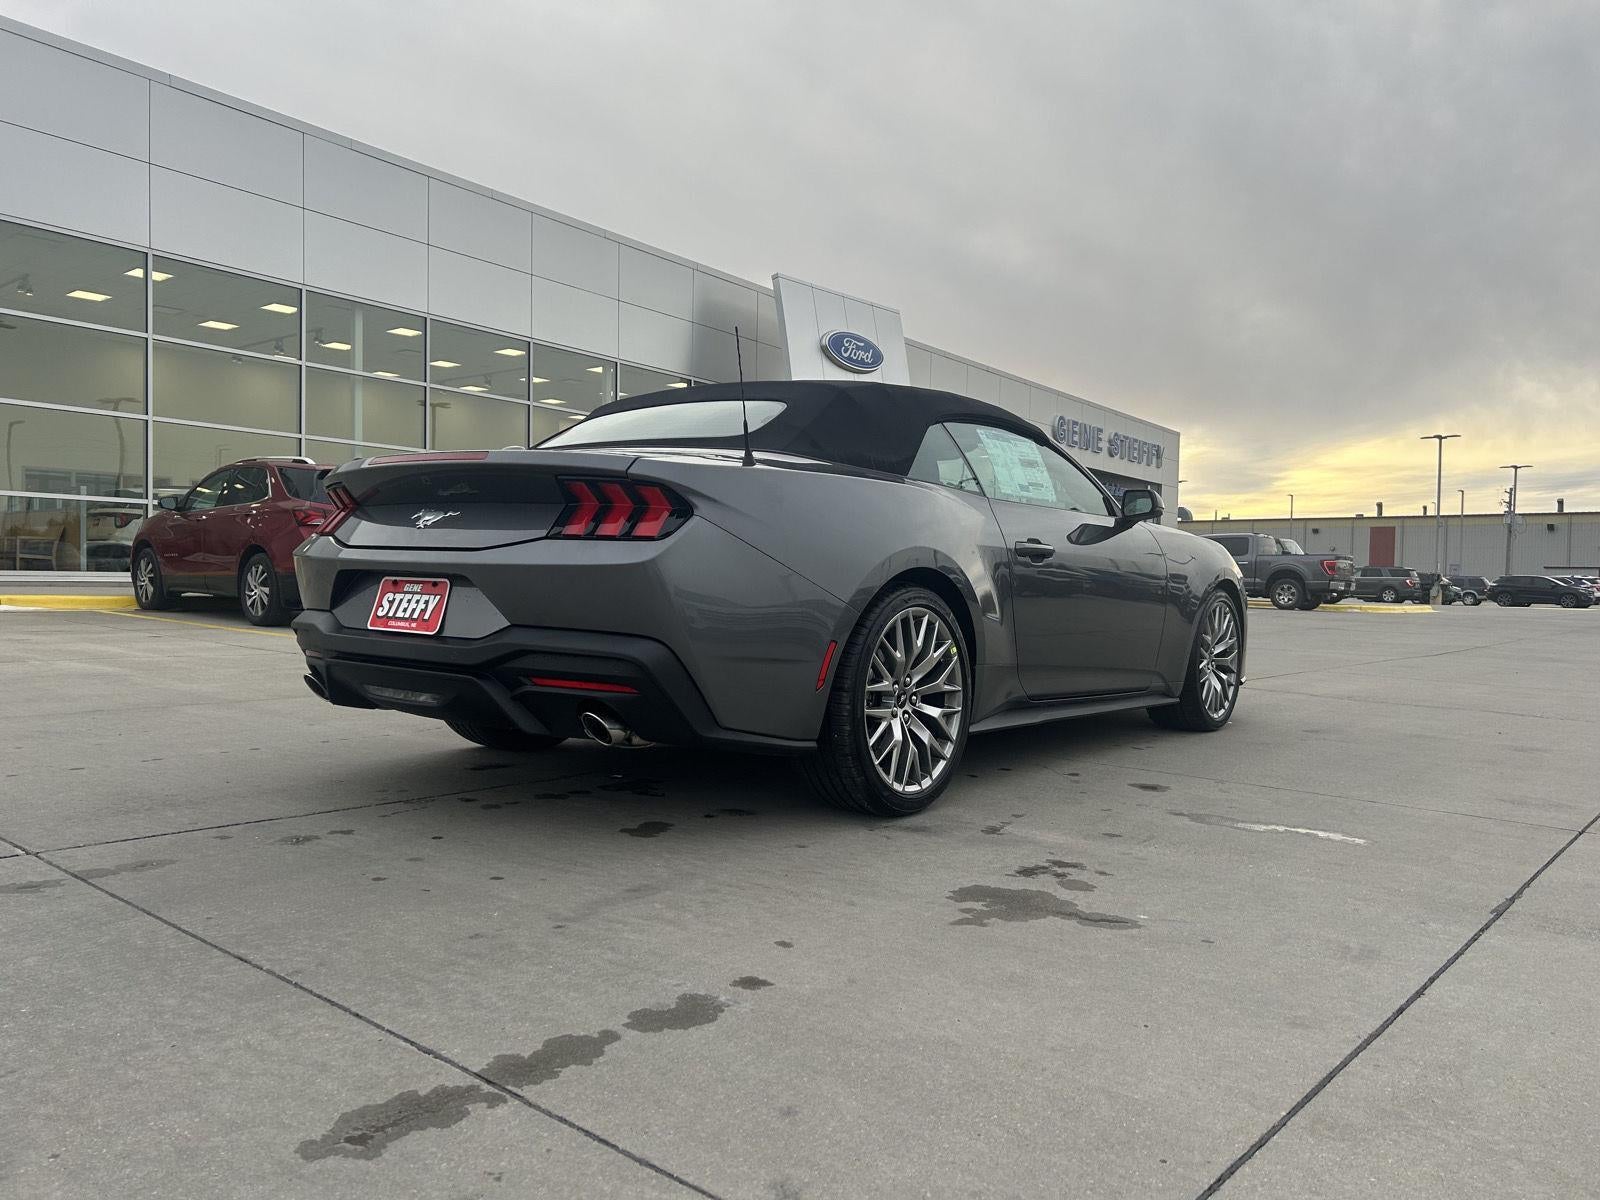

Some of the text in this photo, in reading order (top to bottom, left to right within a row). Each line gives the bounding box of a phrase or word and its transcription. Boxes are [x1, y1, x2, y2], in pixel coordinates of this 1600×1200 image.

[841, 337, 874, 363] Ford
[1053, 415, 1165, 468] GENE STEFFY
[403, 583, 424, 592] GENE
[376, 592, 441, 620] STEFFY
